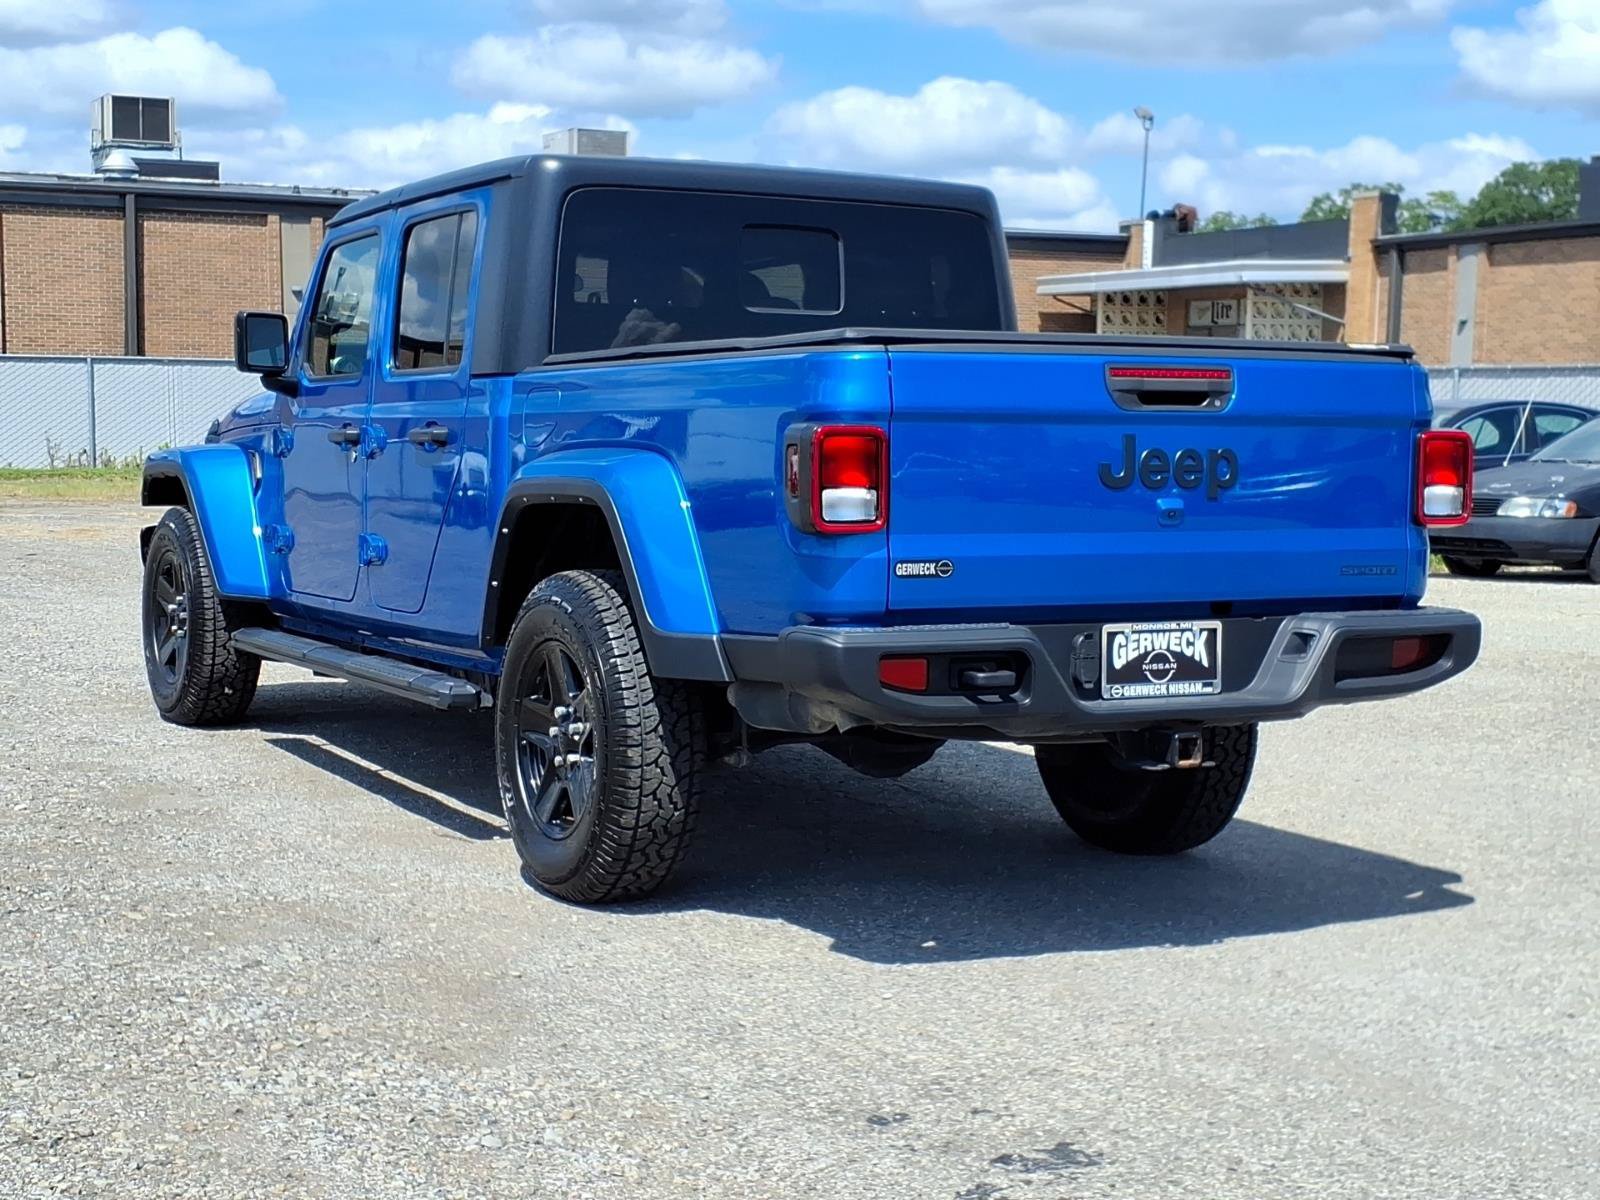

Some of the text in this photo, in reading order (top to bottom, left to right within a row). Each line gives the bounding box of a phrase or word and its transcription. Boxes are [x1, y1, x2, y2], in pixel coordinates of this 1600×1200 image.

[1099, 433, 1238, 502] Jeep
[896, 563, 936, 576] GERWECK
[1113, 631, 1209, 670] GERWECK
[1124, 685, 1167, 696] GERWECK
